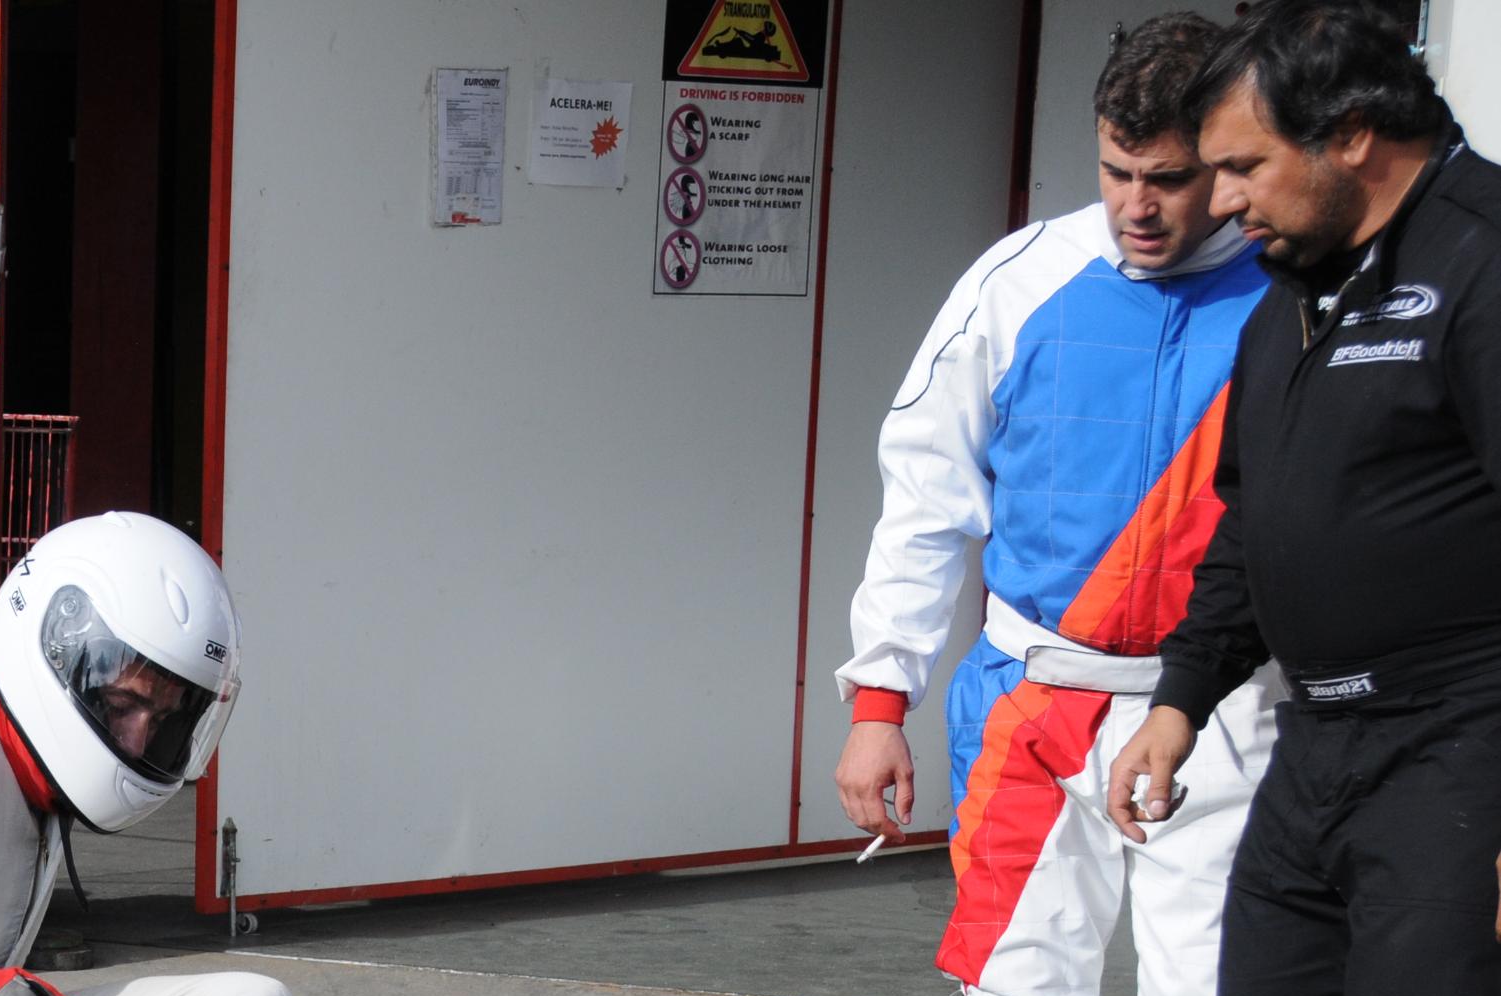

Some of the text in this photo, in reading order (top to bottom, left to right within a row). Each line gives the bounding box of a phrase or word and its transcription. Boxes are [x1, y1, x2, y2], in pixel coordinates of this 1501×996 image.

[724, 1, 771, 19] STRANGULATION
[680, 88, 805, 104] DRIVING IS FORBIDDEN
[550, 97, 612, 112] ACELERA-ME!
[710, 116, 762, 129] WEARING
[709, 132, 750, 142] A SCARF
[708, 170, 811, 184] WEARING LONG HAIR
[707, 185, 804, 197] STICKING OUT FROM
[707, 199, 803, 210] UNDER THE HELMET
[704, 242, 788, 254] WEARING LOOSE
[702, 255, 753, 266] CLOTHING
[205, 643, 227, 661] OMP
